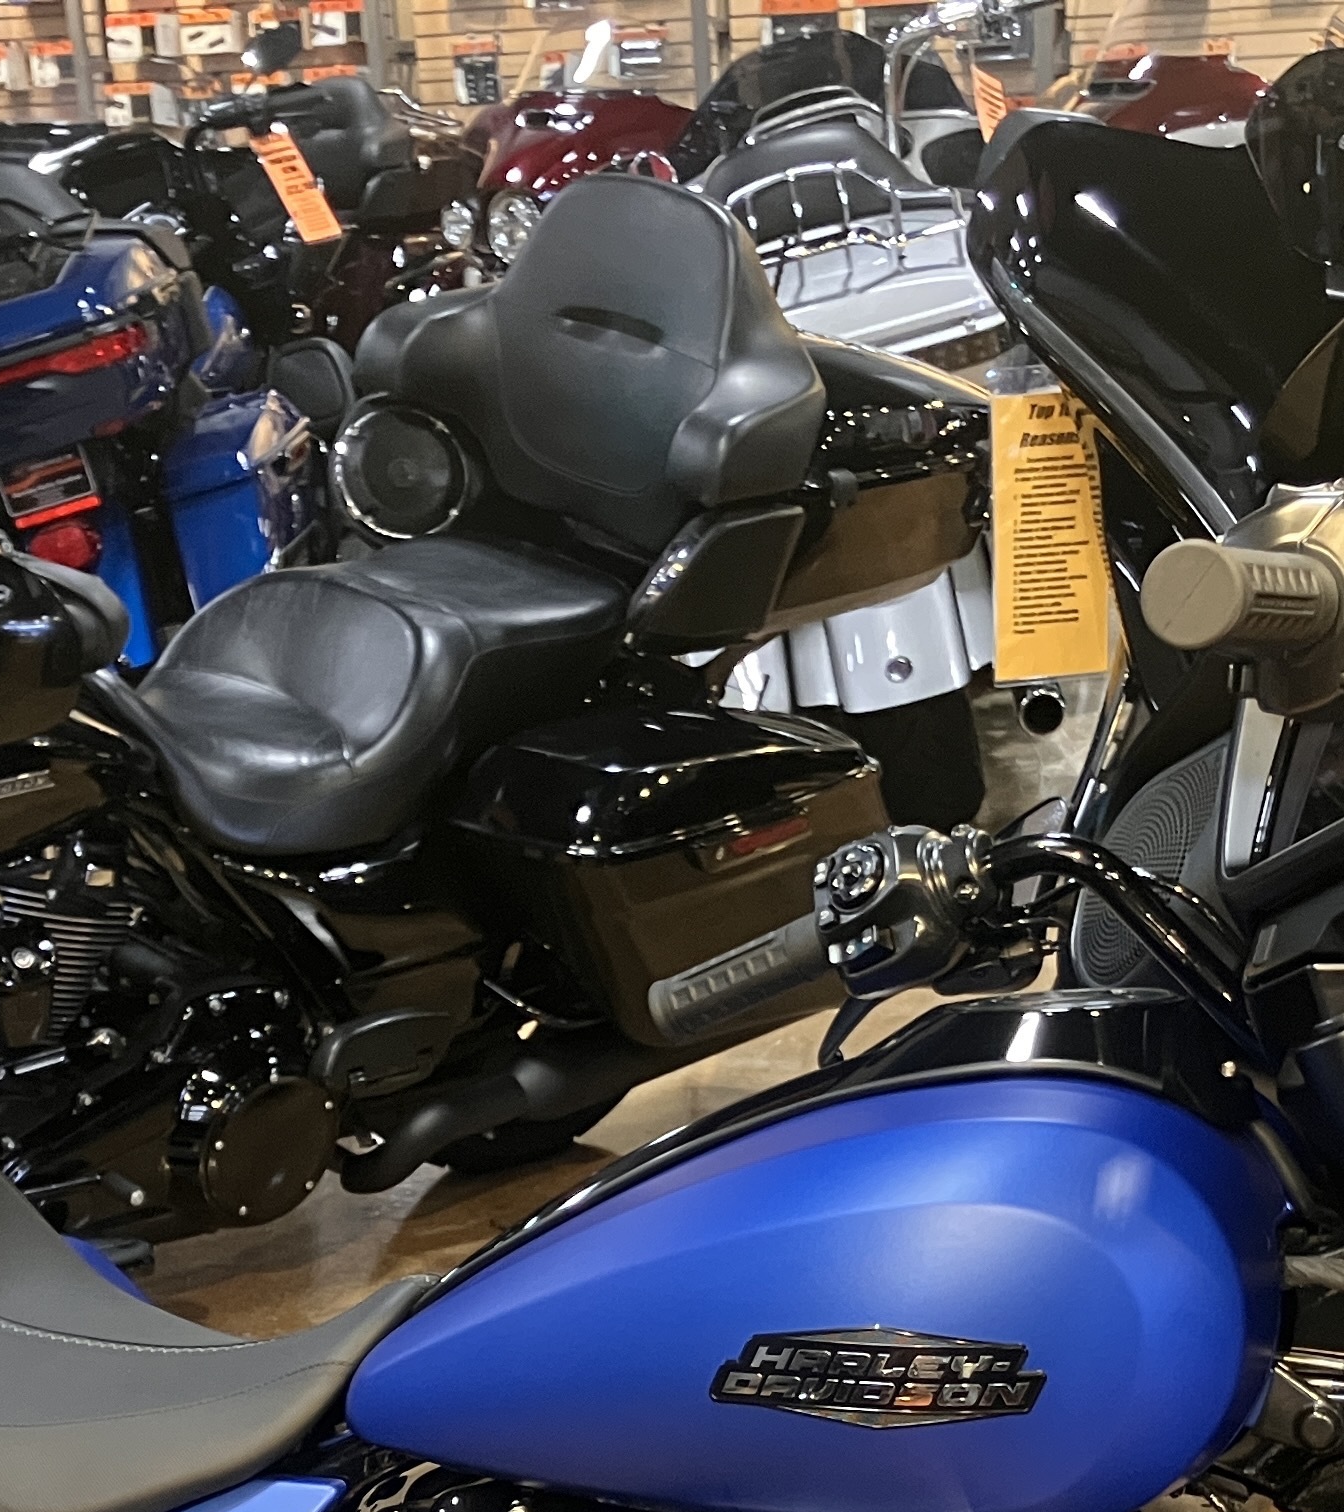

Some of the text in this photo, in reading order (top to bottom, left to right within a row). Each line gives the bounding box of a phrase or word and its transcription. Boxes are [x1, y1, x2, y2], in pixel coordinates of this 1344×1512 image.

[1028, 403, 1056, 420] Top
[1019, 431, 1081, 449] Reasons
[749, 1346, 1012, 1380] HARLEY-
[721, 1371, 1031, 1407] DAVIDSON
